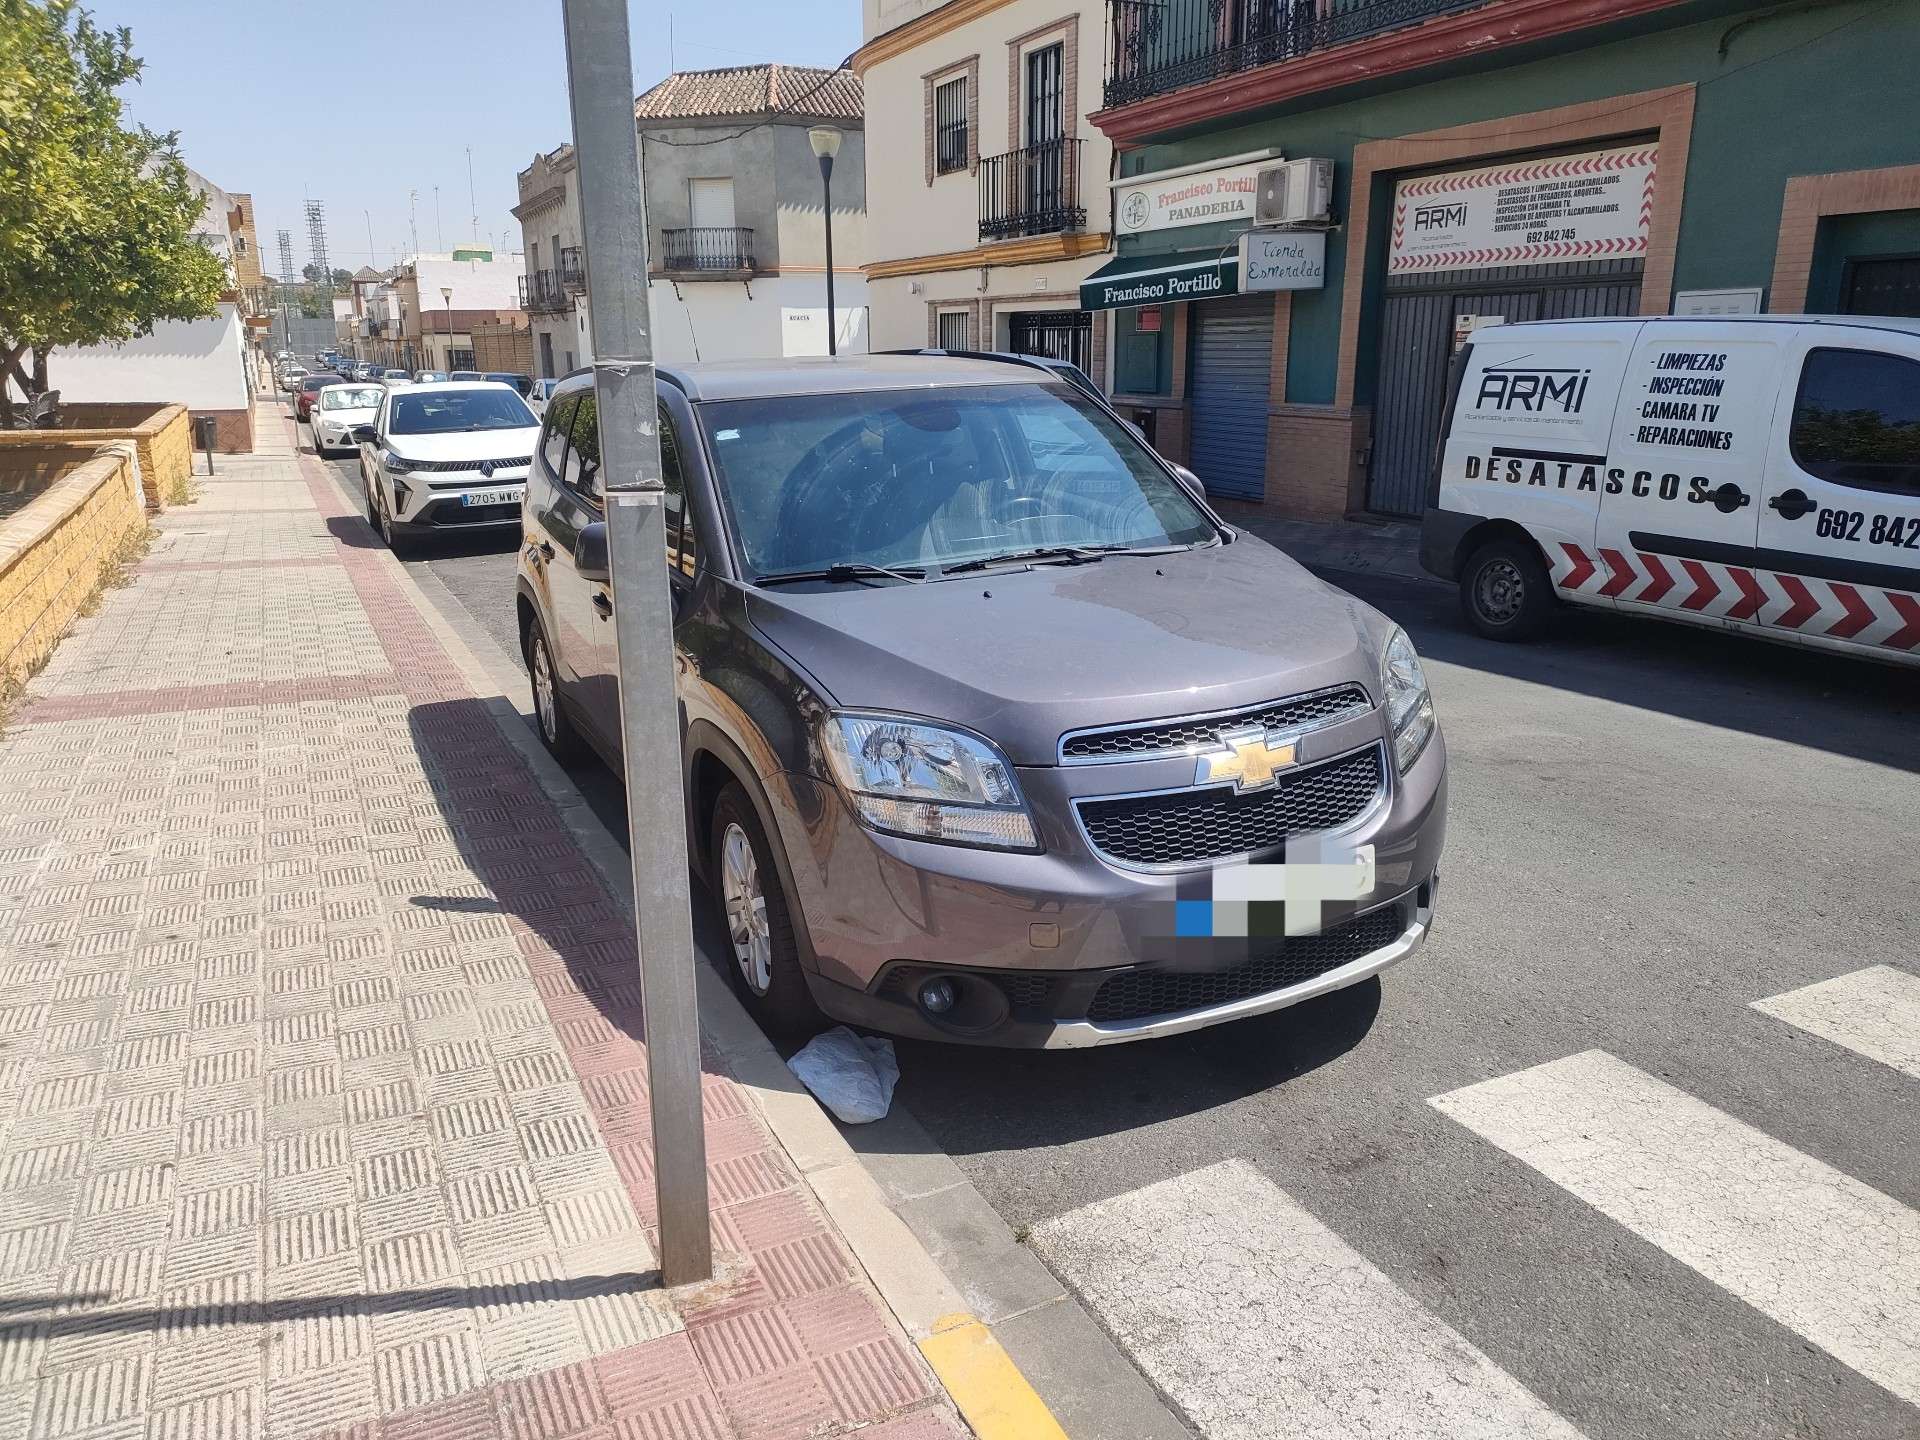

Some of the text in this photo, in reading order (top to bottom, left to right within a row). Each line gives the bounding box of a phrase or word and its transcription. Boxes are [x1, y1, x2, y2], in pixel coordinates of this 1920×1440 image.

[1158, 177, 1257, 209] Francisco Portill
[1561, 181, 1568, 190] DE
[1526, 228, 1576, 243] 692 842 745
[1262, 241, 1305, 258] Tienda
[1248, 260, 1321, 279] Esmeralda
[1103, 273, 1221, 303] Francisco Portillo
[1656, 353, 1727, 371] LIMPIEZAS
[1648, 376, 1725, 397] INSPECCIÓN
[1641, 401, 1720, 422] CAMARA TV
[1636, 426, 1733, 450] REPARACIONES
[1465, 456, 1709, 503] DESATASCOS
[469, 493, 496, 504] 2705
[500, 492, 519, 502] MWG
[1816, 509, 1920, 549] 692 842
